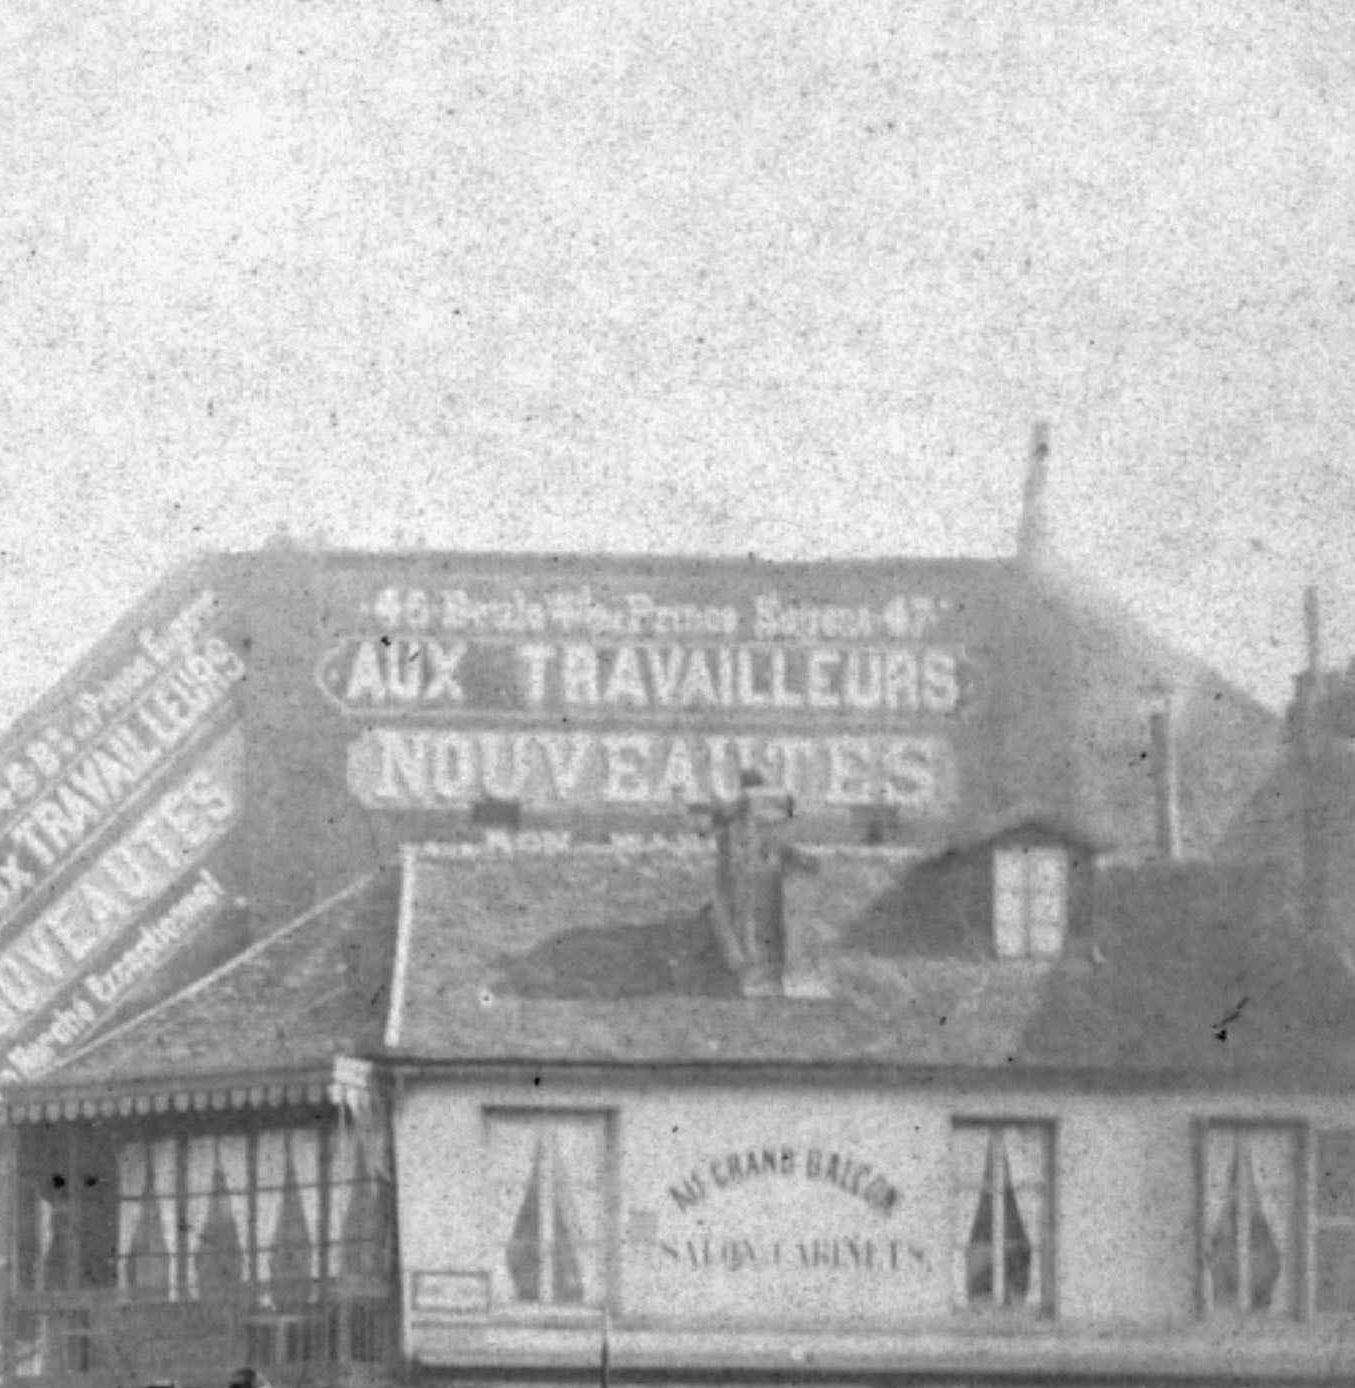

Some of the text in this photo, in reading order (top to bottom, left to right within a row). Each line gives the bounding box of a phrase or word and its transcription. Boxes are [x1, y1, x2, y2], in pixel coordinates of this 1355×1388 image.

[346, 641, 958, 709] AUX TRAVAILLEURS
[11, 635, 246, 865] TRAVAILLEURS
